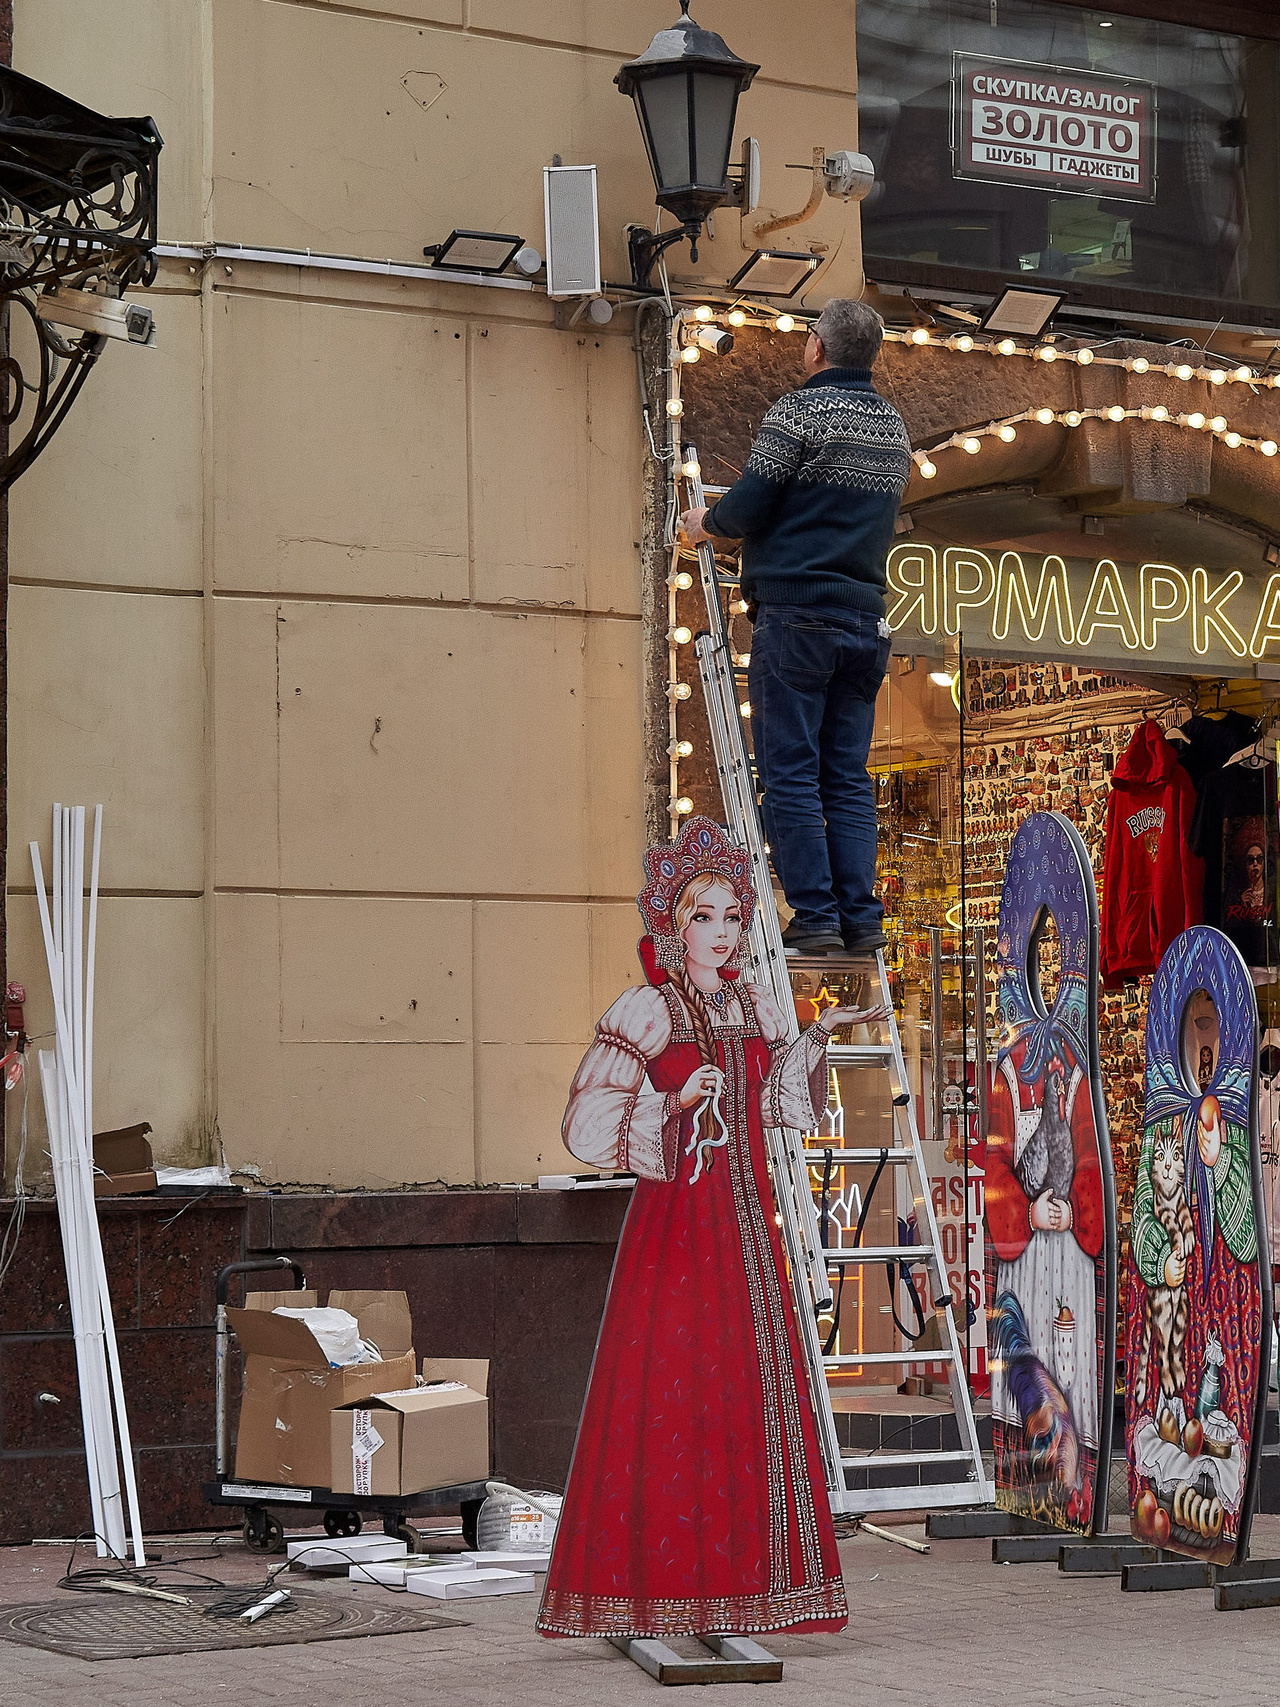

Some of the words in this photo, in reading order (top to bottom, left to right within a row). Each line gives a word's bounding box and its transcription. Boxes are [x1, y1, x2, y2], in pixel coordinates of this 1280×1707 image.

[972, 75, 1140, 116] СКУПКА/ЗАЛОГ
[981, 105, 1133, 154] ЗОЛОТО
[986, 147, 1037, 167] ШУБЫ
[1058, 157, 1135, 180] ГАДЖЕТЫ
[927, 1175, 985, 1217] AST
[942, 1222, 976, 1264] OF
